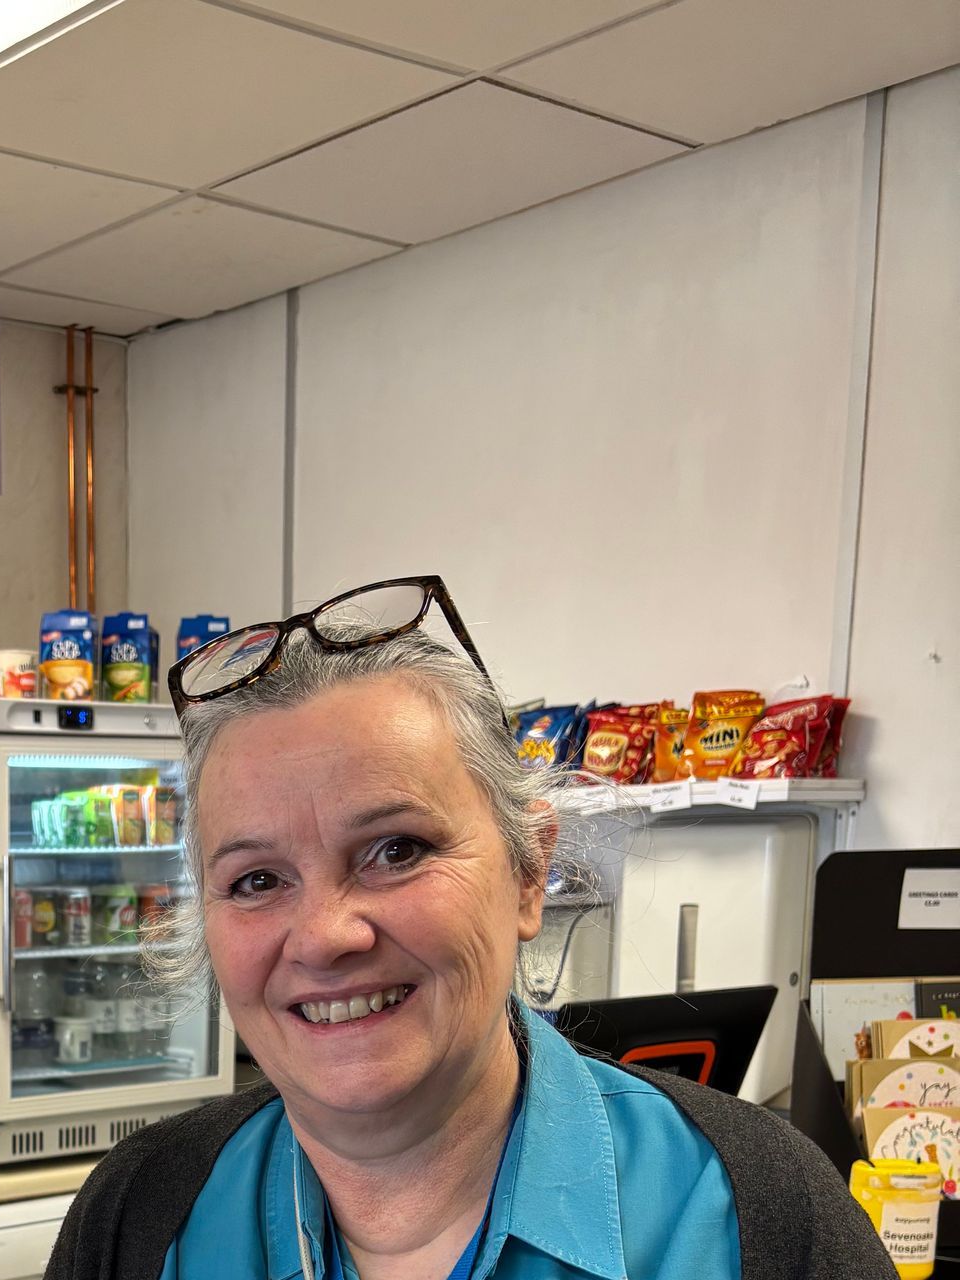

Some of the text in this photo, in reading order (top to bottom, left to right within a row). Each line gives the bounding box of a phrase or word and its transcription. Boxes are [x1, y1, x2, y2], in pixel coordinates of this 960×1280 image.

[700, 727, 740, 745] MINI
[883, 1230, 934, 1241] Sevenoaks
[889, 1242, 929, 1254] Hospital
